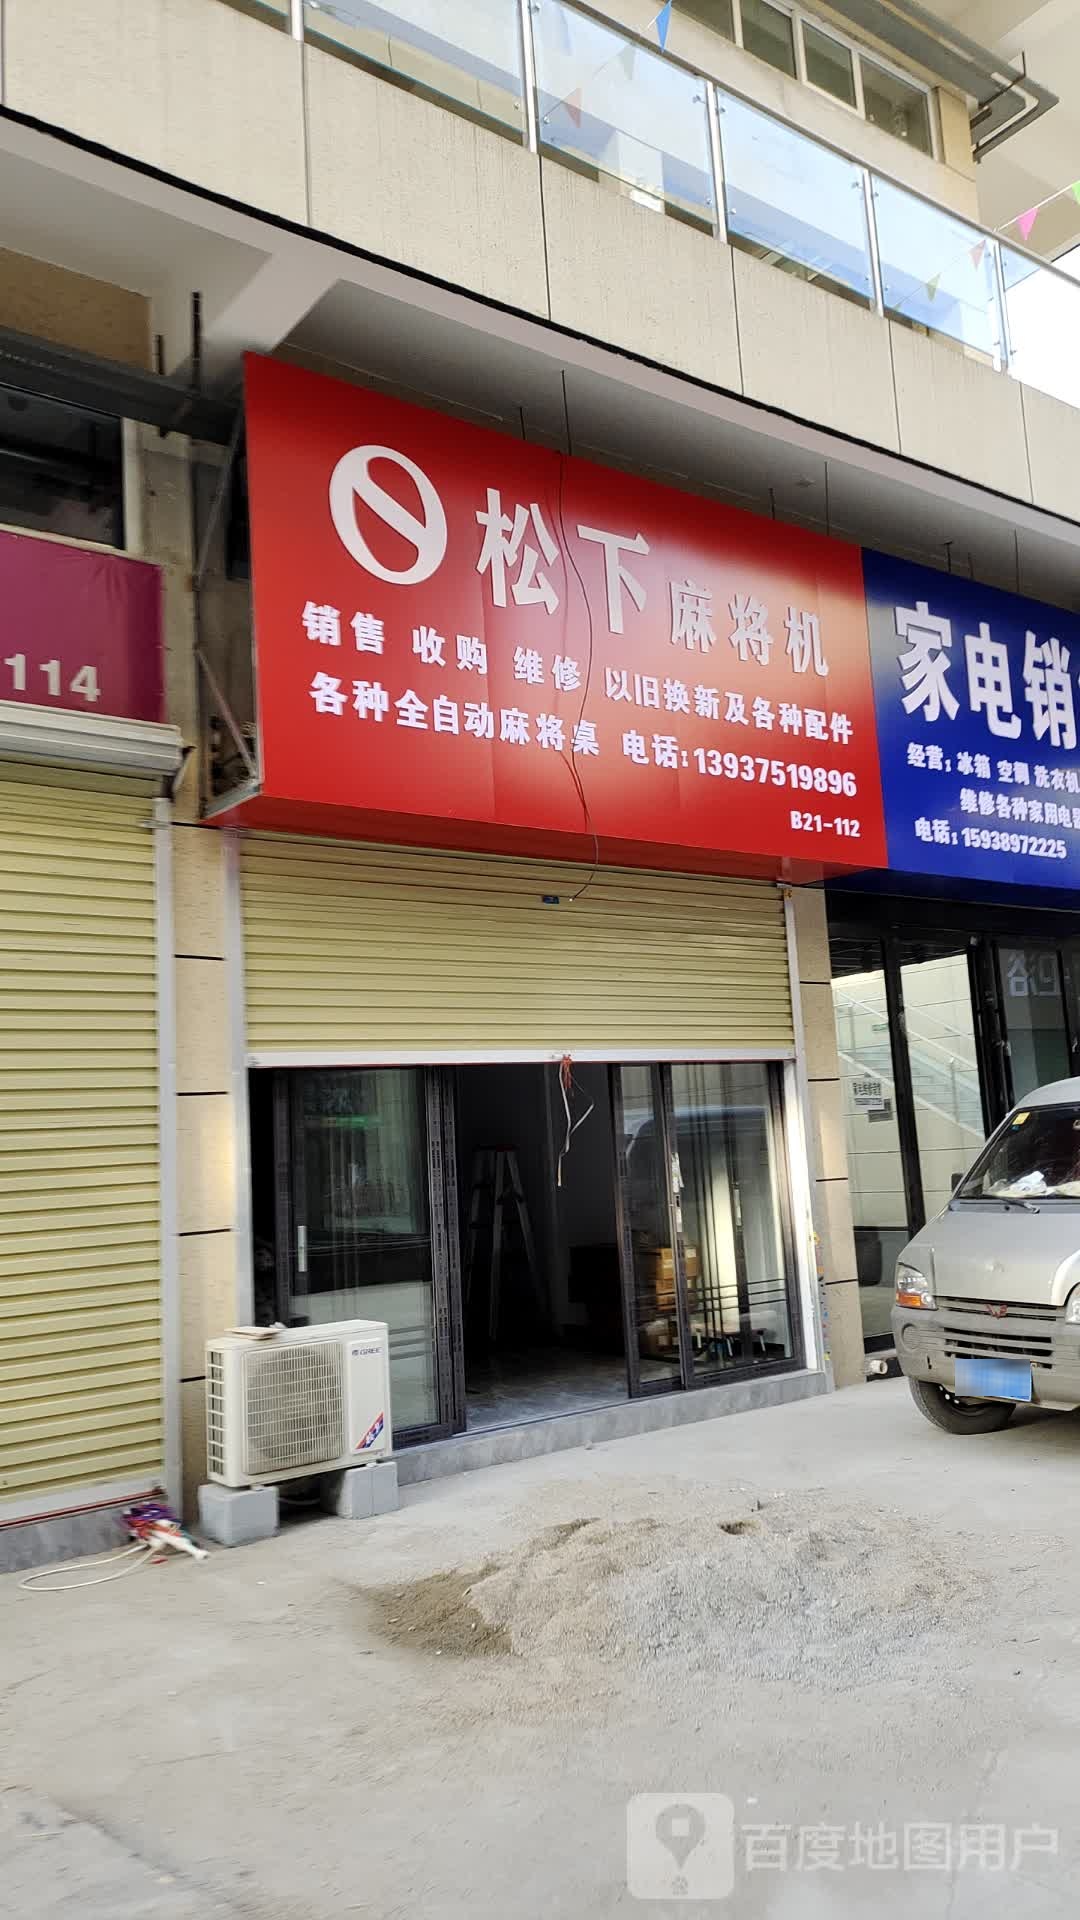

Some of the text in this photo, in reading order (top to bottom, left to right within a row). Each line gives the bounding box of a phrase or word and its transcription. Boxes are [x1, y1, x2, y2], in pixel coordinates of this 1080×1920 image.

[302, 601, 854, 745] 销售 收购 维修 以旧换新及各种配件
[310, 671, 600, 756] 各种全自动麻将桌
[894, 601, 1080, 750] 家电销
[790, 810, 861, 838] B21-112
